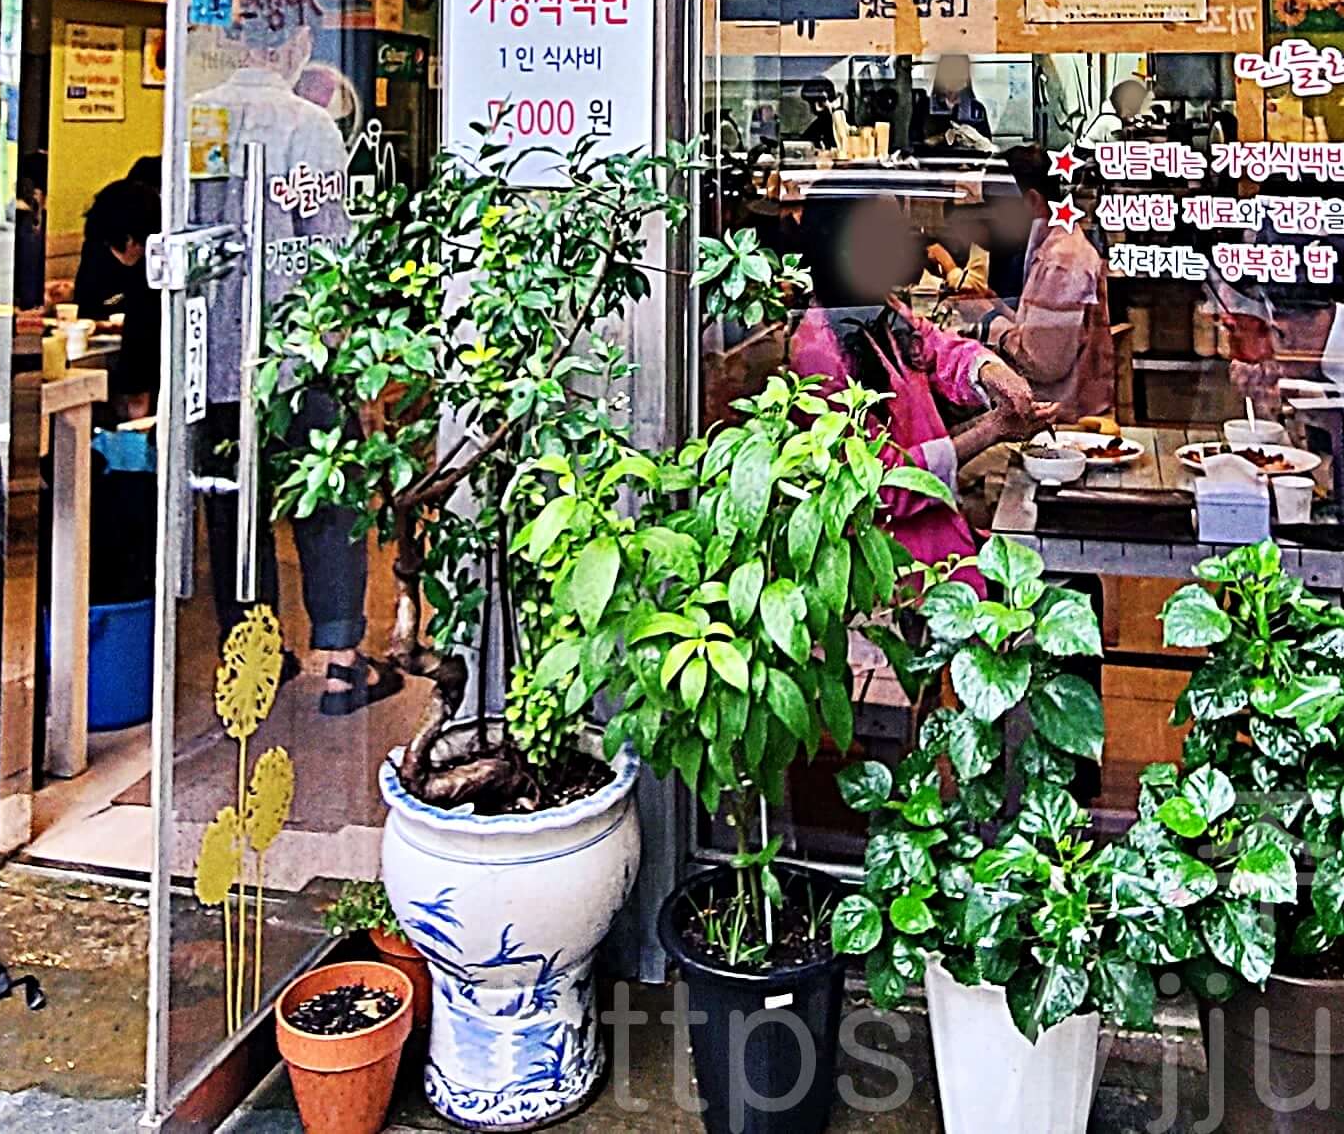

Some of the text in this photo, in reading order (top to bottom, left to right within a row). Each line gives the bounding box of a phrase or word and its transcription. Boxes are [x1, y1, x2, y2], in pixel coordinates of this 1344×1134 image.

[543, 46, 601, 72] 식사비
[587, 99, 612, 136] 원
[1100, 143, 1205, 178] 민들레는
[271, 162, 343, 216] 민들레
[1100, 197, 1176, 229] 신선한
[1183, 199, 1262, 228] 재료와
[1111, 245, 1206, 277] 차려지는
[1216, 245, 1298, 280] 행복한
[1306, 247, 1336, 280] 밥
[189, 308, 203, 415] 당기시오
